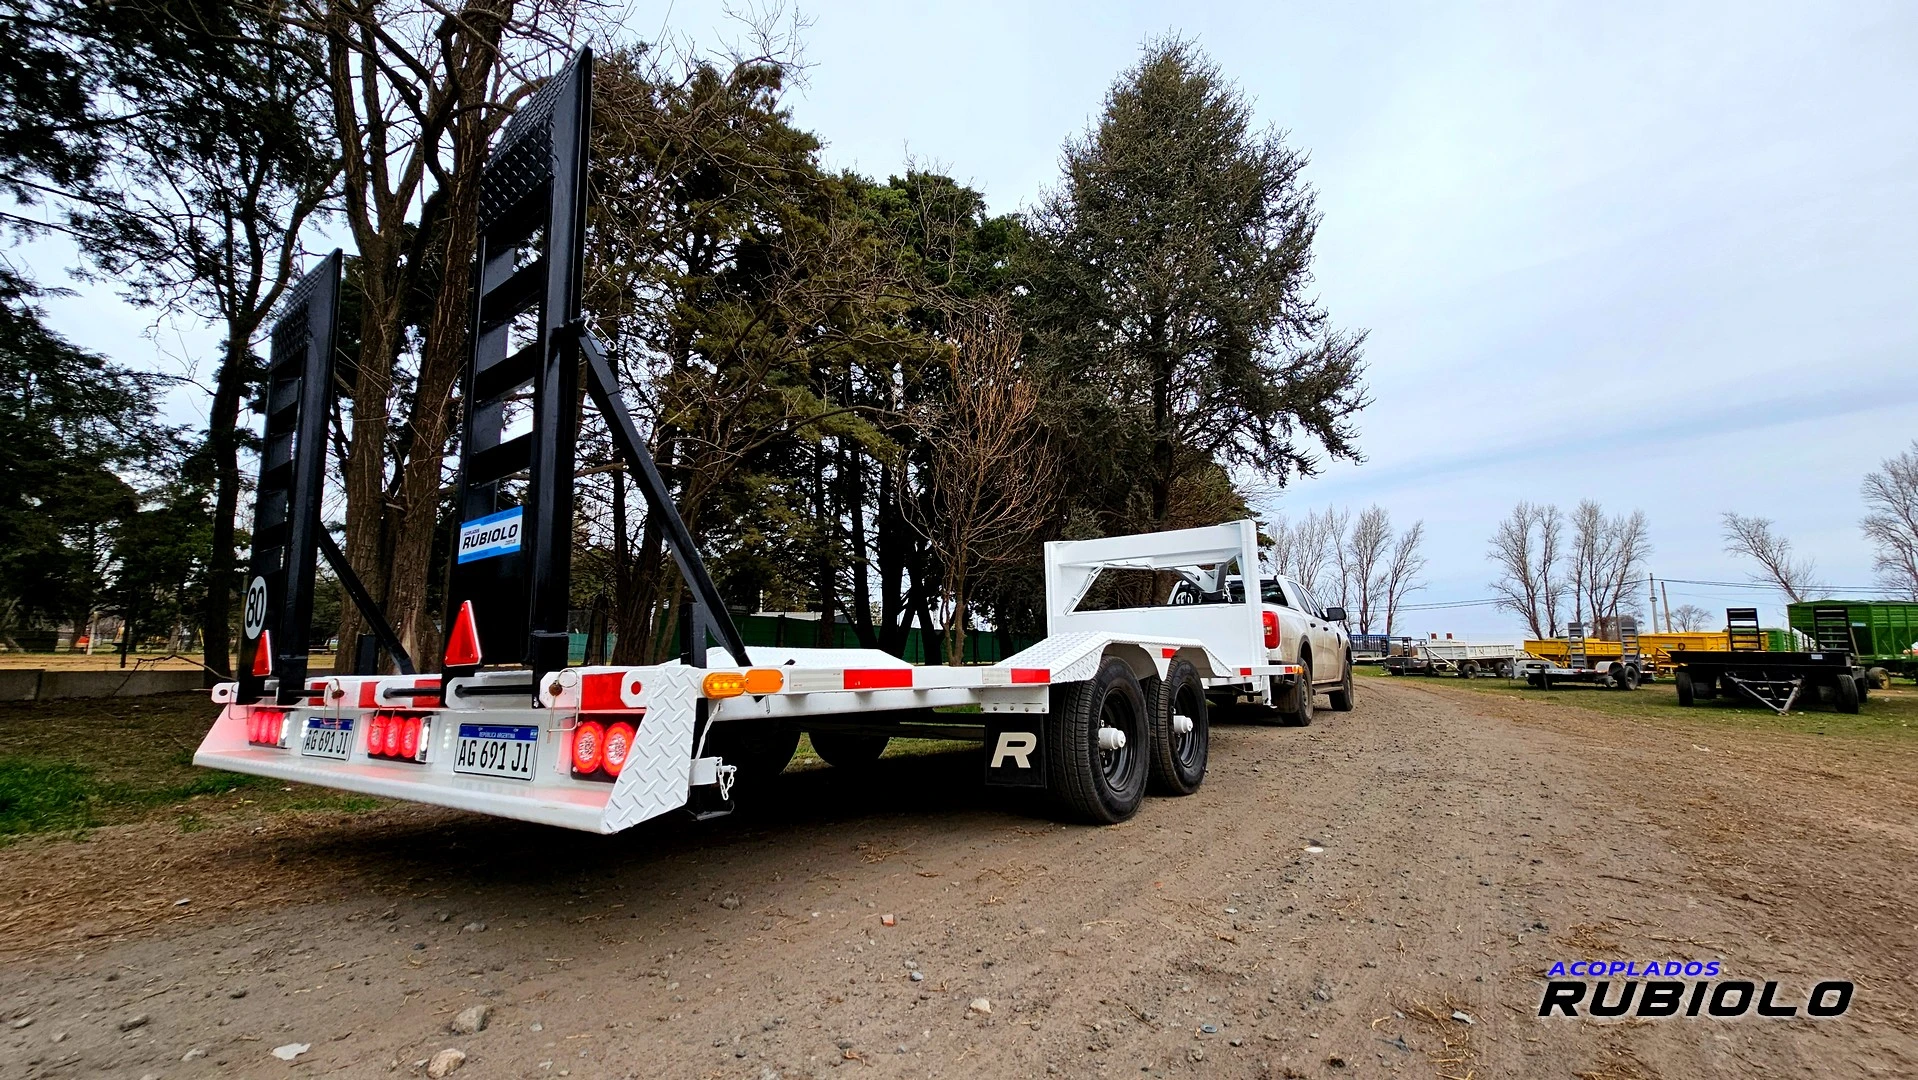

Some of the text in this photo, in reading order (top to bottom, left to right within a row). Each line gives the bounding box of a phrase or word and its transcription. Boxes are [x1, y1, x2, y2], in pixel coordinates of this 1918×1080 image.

[462, 524, 518, 549] RUBIOLO
[246, 586, 264, 628] 80
[304, 729, 349, 754] AG 691 JI
[457, 739, 531, 773] AG 691 JI
[990, 732, 1037, 768] R
